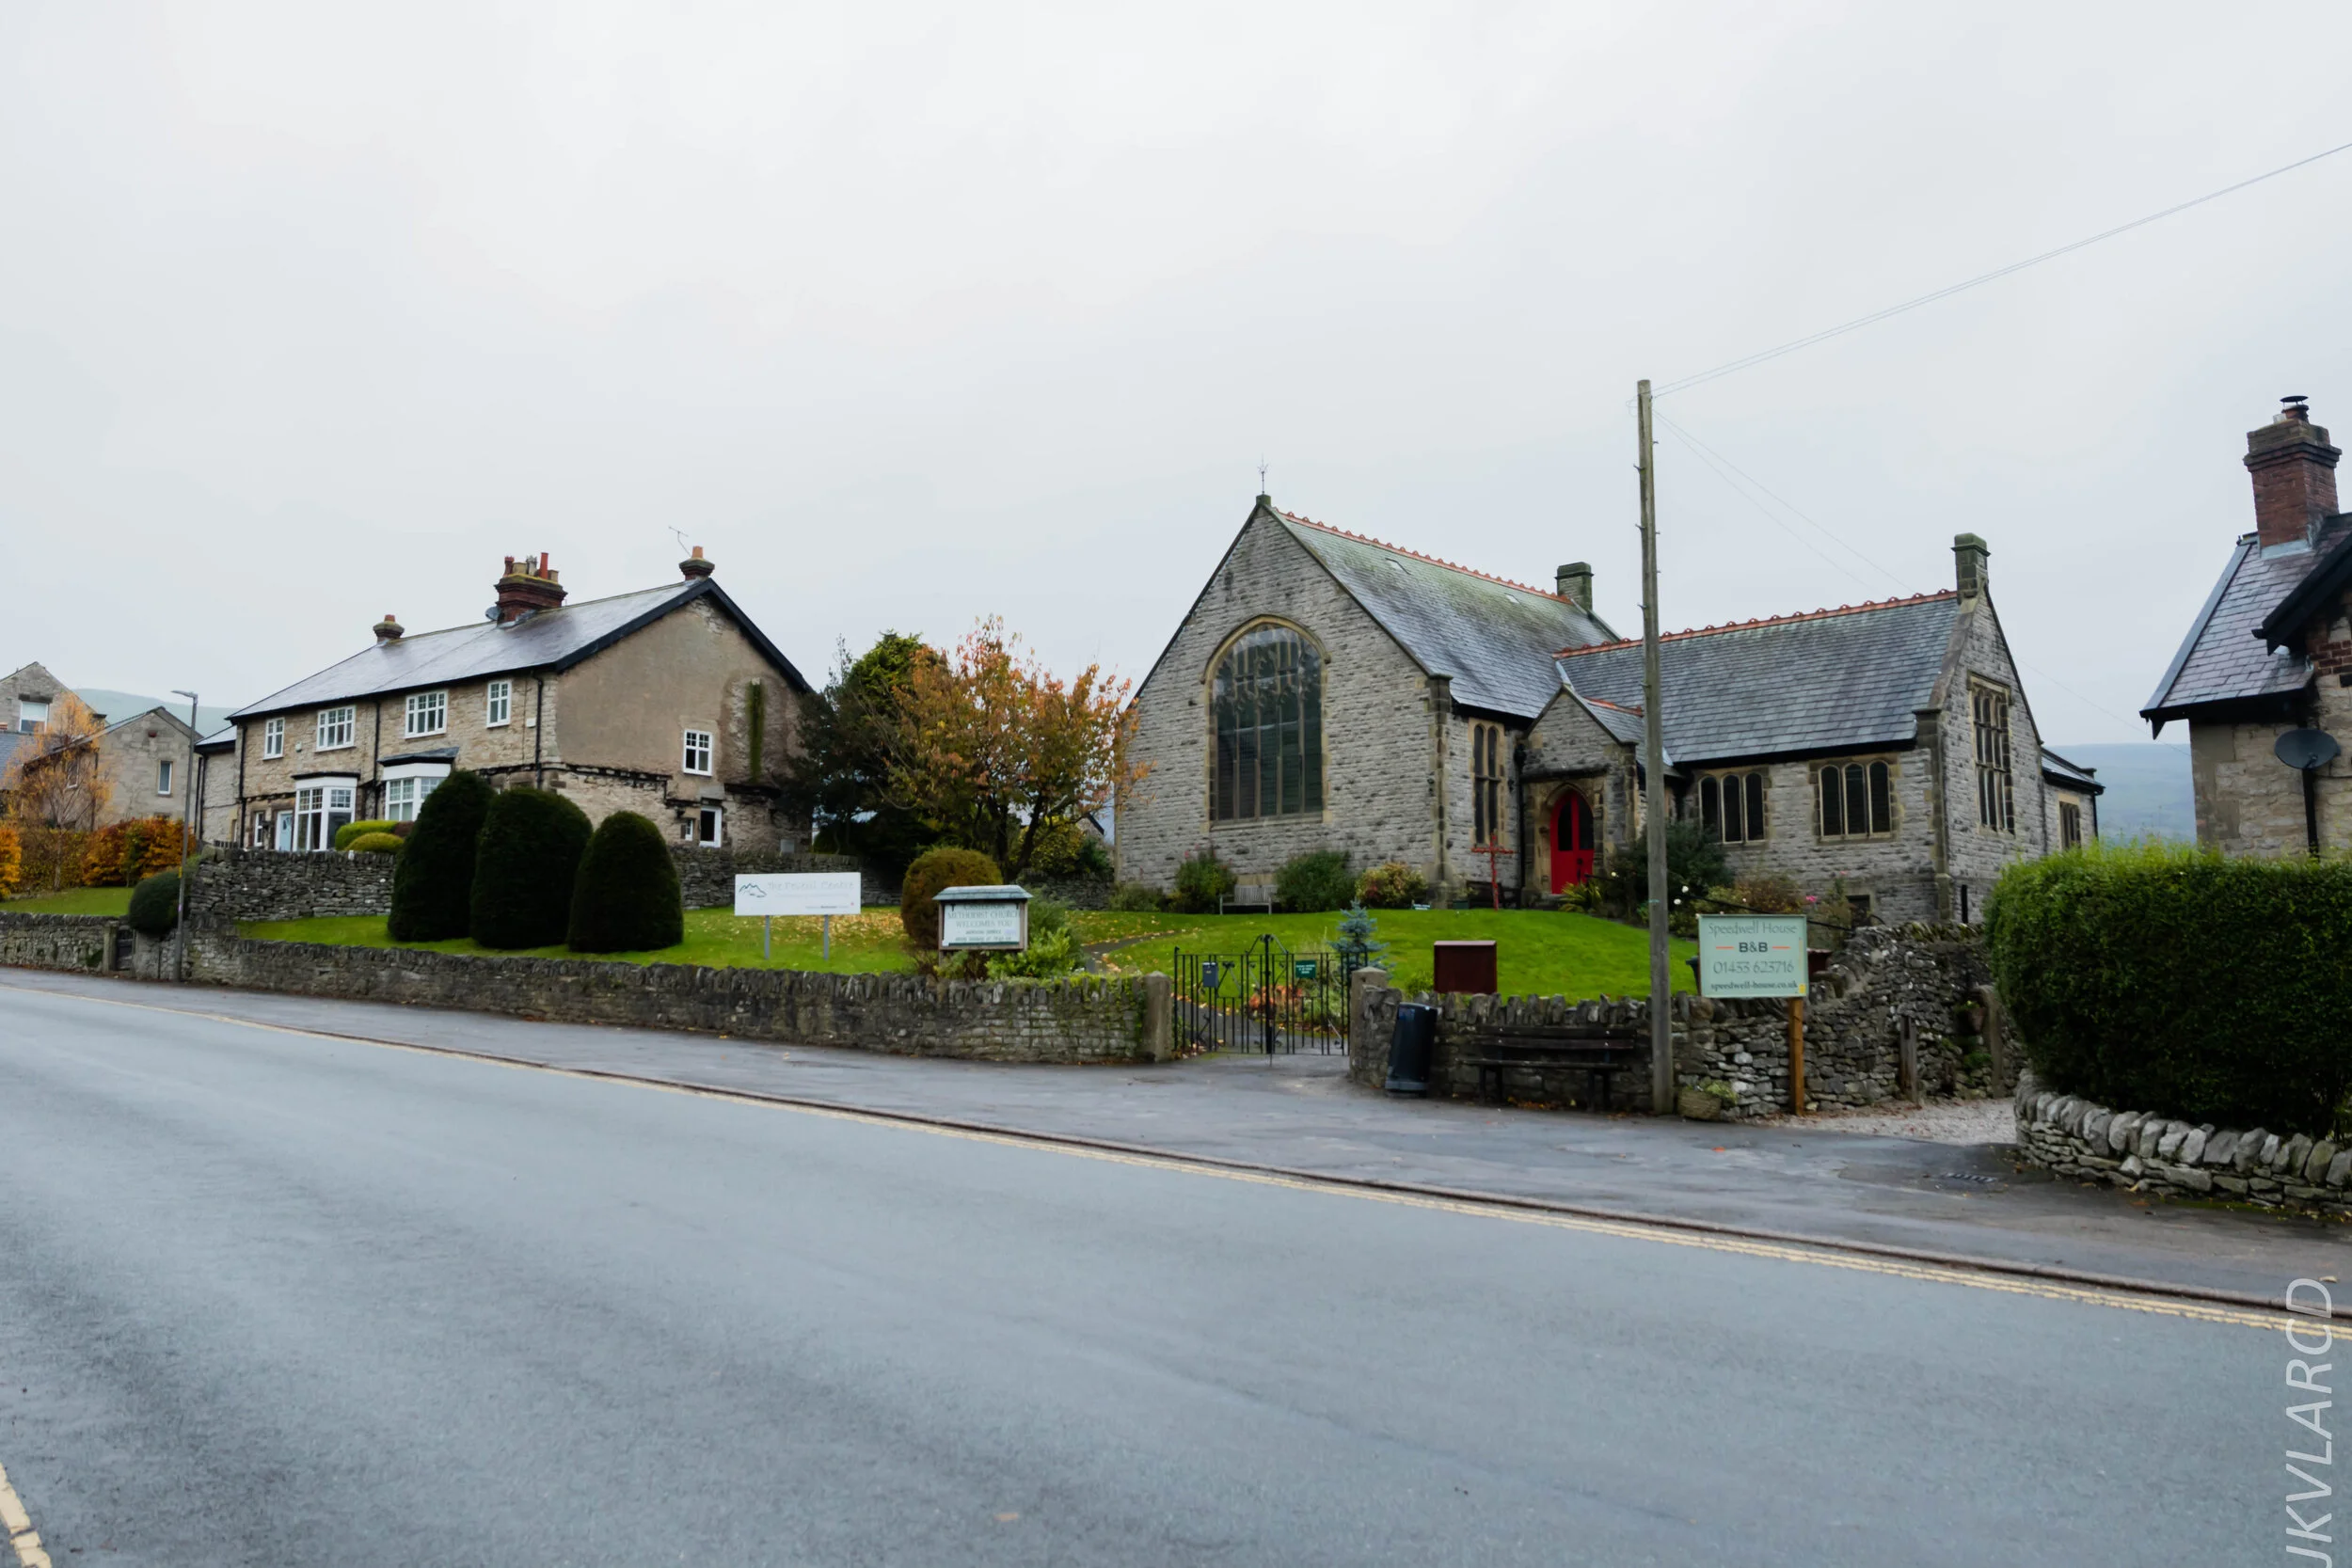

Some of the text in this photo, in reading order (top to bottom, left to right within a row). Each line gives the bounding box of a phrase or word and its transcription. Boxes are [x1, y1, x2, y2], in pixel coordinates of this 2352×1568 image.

[948, 911, 988, 919] METHODIST
[1708, 920, 1798, 938] Speedwell House
[1739, 942, 1769, 953] B&B
[1713, 959, 1795, 974] 01433 623716
[1710, 980, 1798, 991] speedwell-house.co.uk
